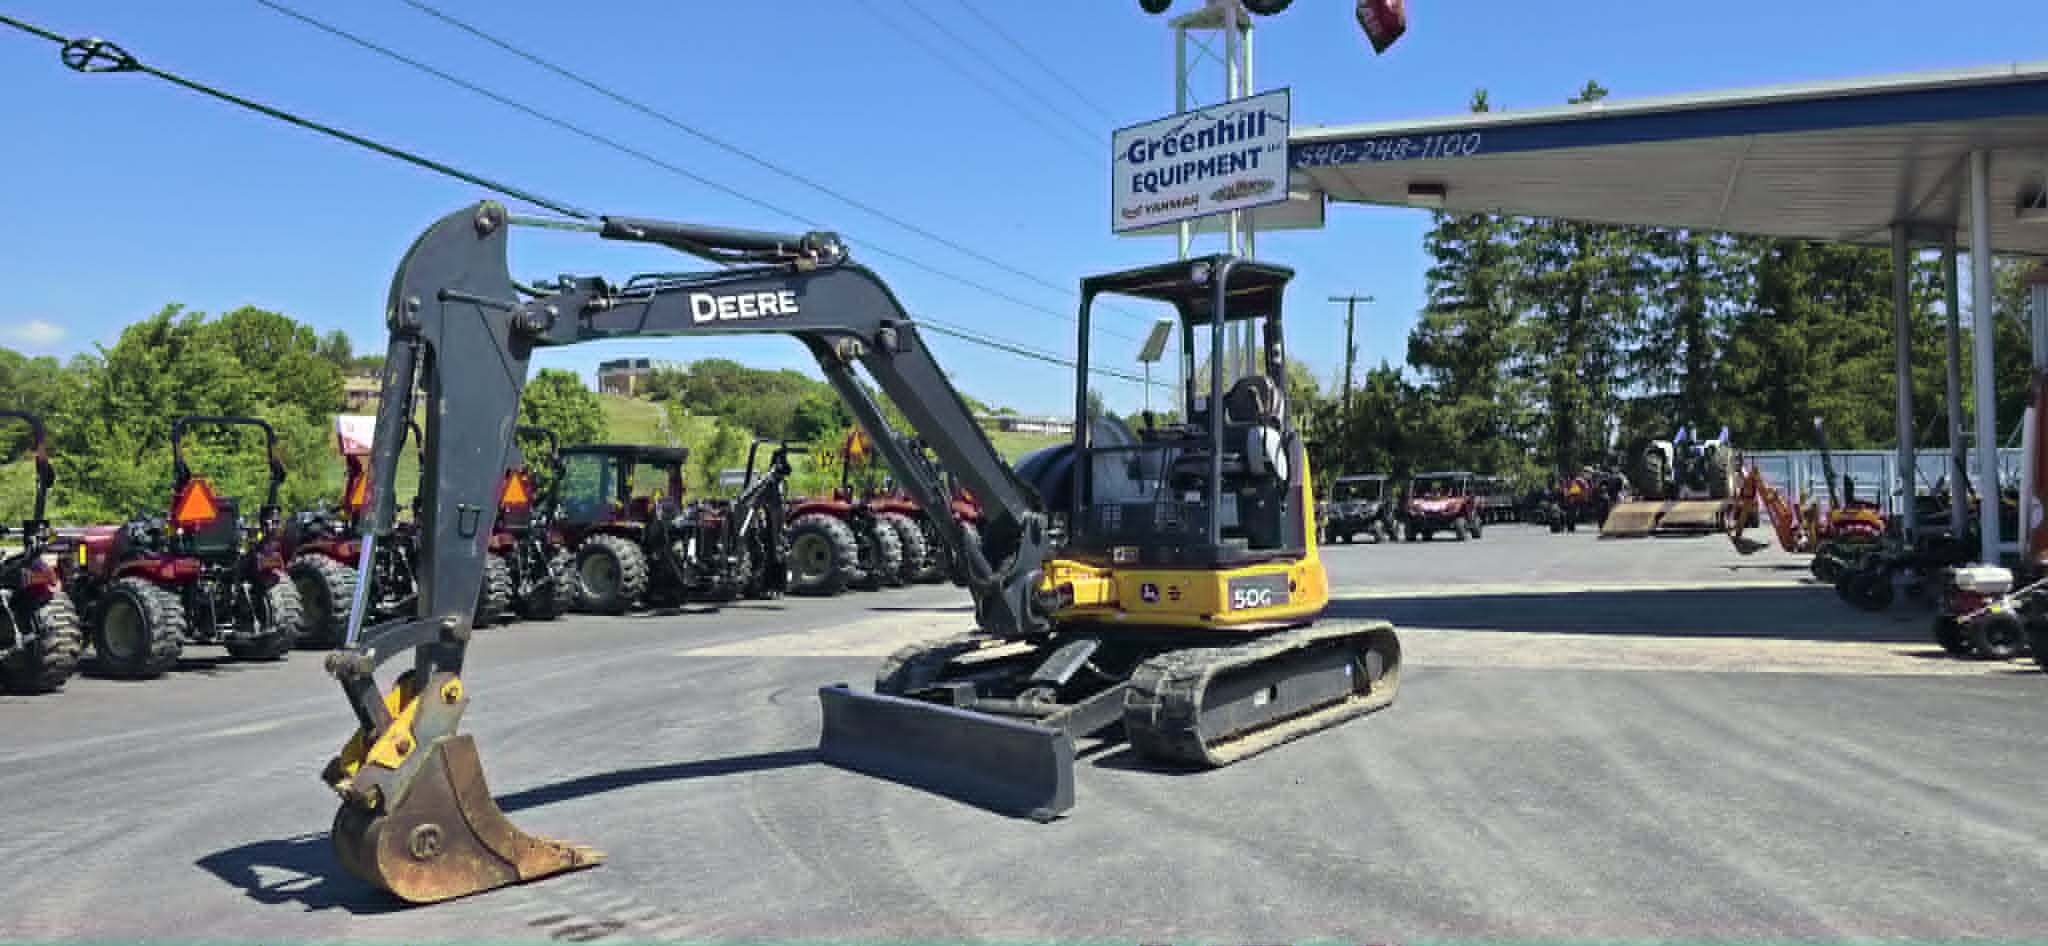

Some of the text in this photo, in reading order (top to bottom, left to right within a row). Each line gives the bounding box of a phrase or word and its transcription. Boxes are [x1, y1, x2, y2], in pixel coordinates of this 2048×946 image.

[1128, 109, 1265, 163] Greenhill
[1297, 131, 1481, 168] 540-248-1100
[1132, 146, 1262, 192] EQUIPMENT
[690, 290, 799, 322] DEERE
[1232, 588, 1272, 609] 50G
